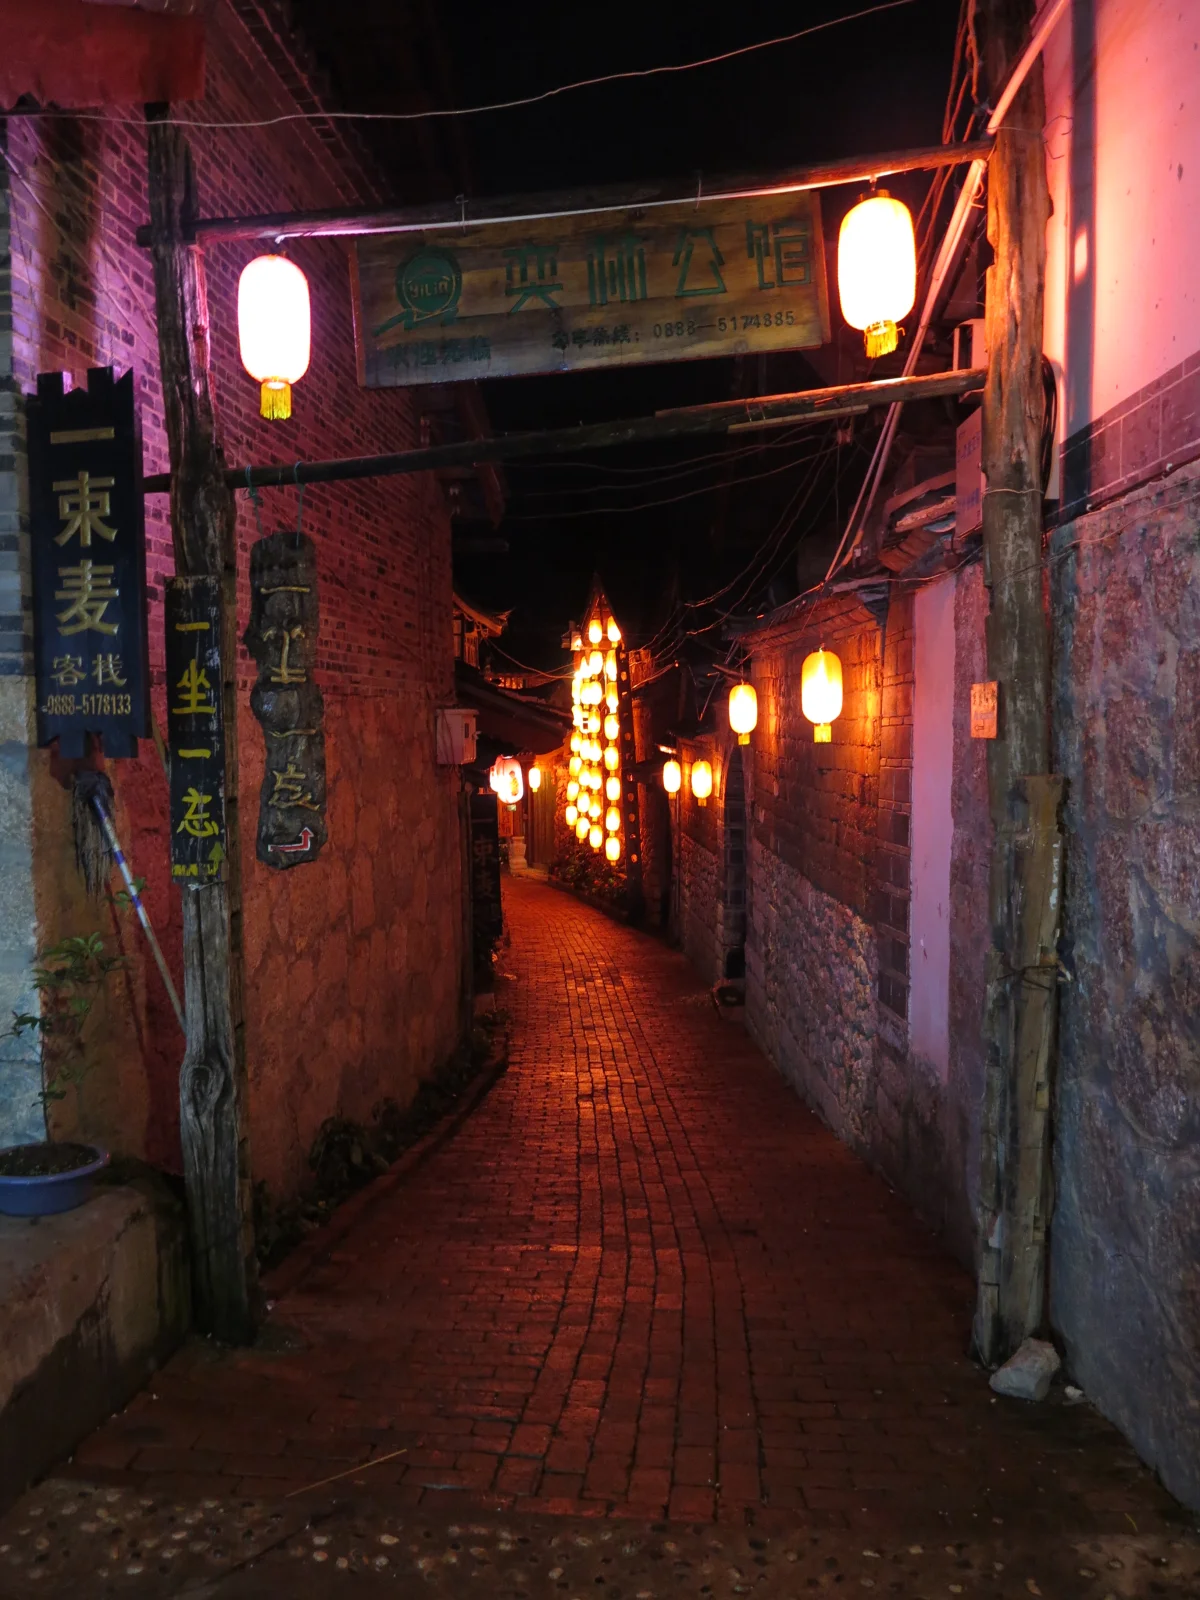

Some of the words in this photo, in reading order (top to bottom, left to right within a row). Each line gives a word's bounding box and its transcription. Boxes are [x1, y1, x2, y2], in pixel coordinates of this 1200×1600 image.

[503, 218, 811, 313] 奕林公馆
[386, 335, 492, 368] 欢迎光临
[49, 426, 120, 637] 一束麦
[50, 653, 127, 688] 客栈
[46, 694, 132, 716] 0888-5178133
[172, 621, 220, 838] 一坐一忘
